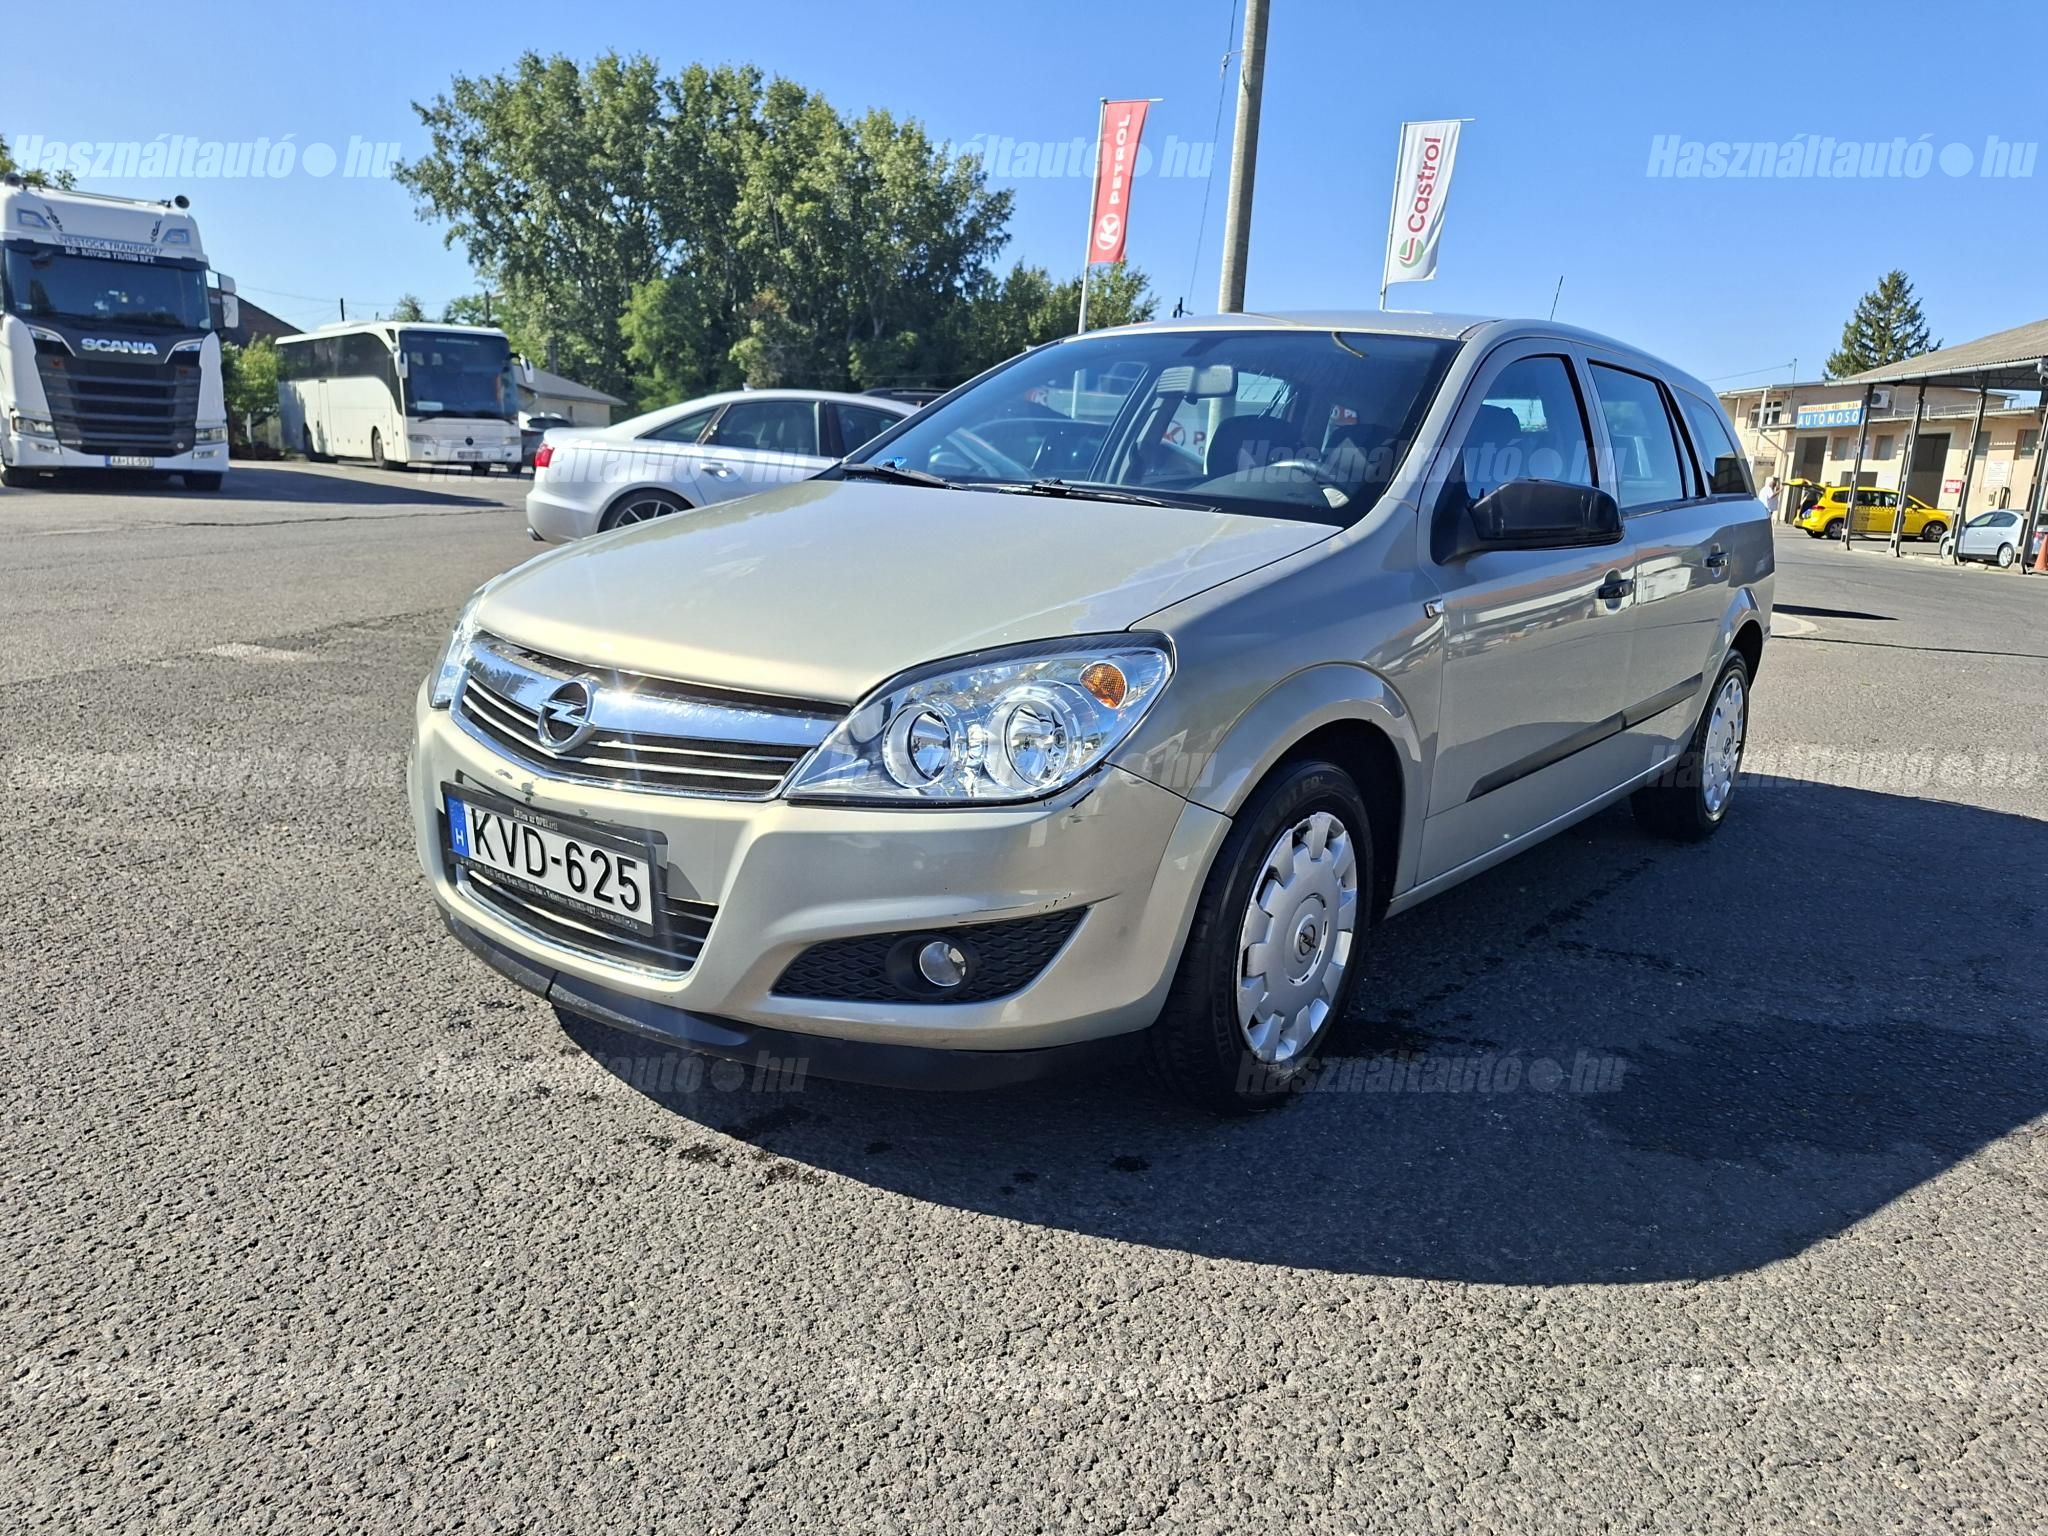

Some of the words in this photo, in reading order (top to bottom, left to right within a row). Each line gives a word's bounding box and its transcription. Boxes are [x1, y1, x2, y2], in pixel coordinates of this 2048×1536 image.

[1110, 113, 1131, 205] PETROL
[1408, 137, 1441, 233] Castrol
[108, 240, 164, 256] TRANSPORT
[81, 338, 158, 355] SCANIA
[456, 829, 465, 847] H
[471, 808, 642, 912] KVD-625
